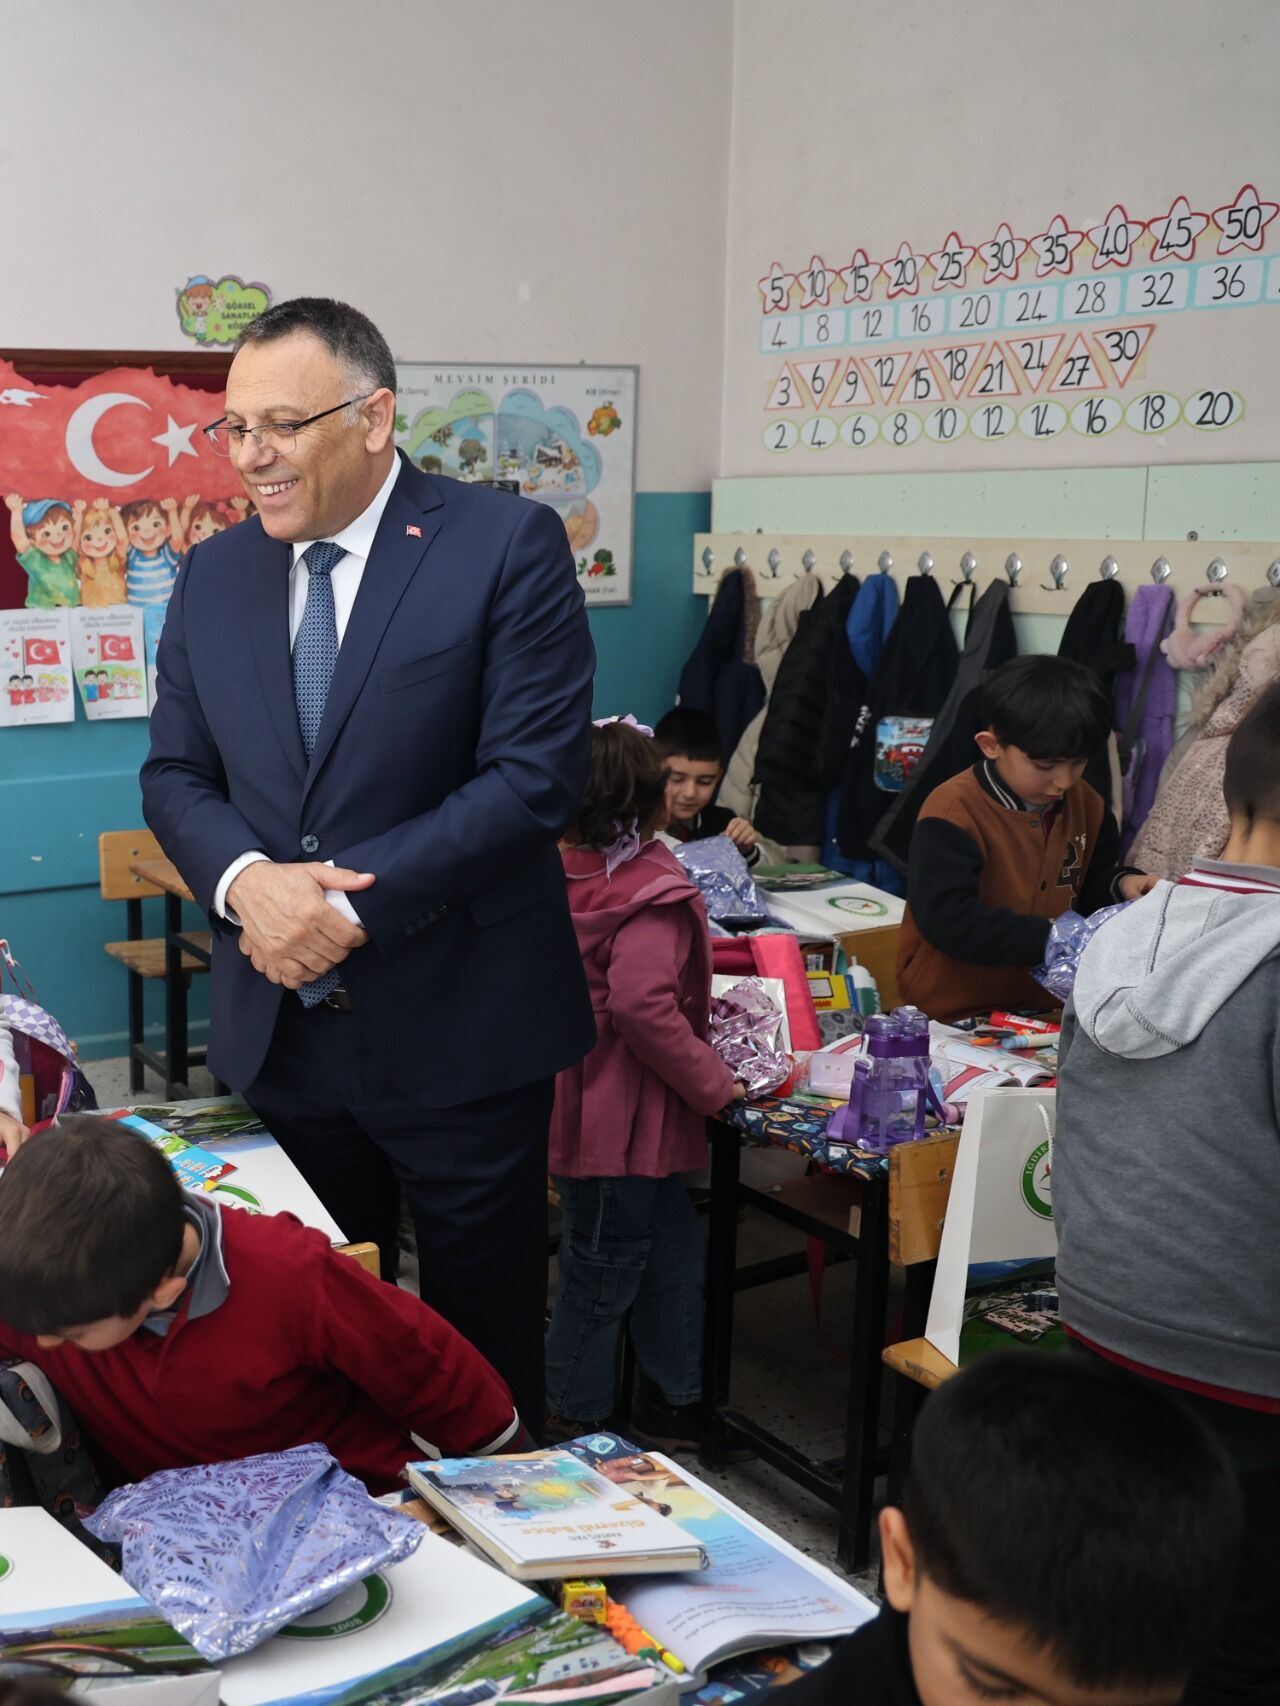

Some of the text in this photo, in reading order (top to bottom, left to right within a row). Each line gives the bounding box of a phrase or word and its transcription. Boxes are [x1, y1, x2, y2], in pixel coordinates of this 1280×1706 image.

[770, 201, 1264, 306] 5 10 15 20 25 30 35 40 45 50
[771, 264, 1246, 348] 4 8 12 16 20 24 28 32 36
[434, 374, 556, 385] MEVSİM ŞERİDİ
[777, 329, 1140, 407] 3 6 9 12 15 18 21 24 27 30
[773, 390, 1234, 449] 2 4 6 8 10 12 14 16 18 20
[330, 1617, 364, 1634] 2008
